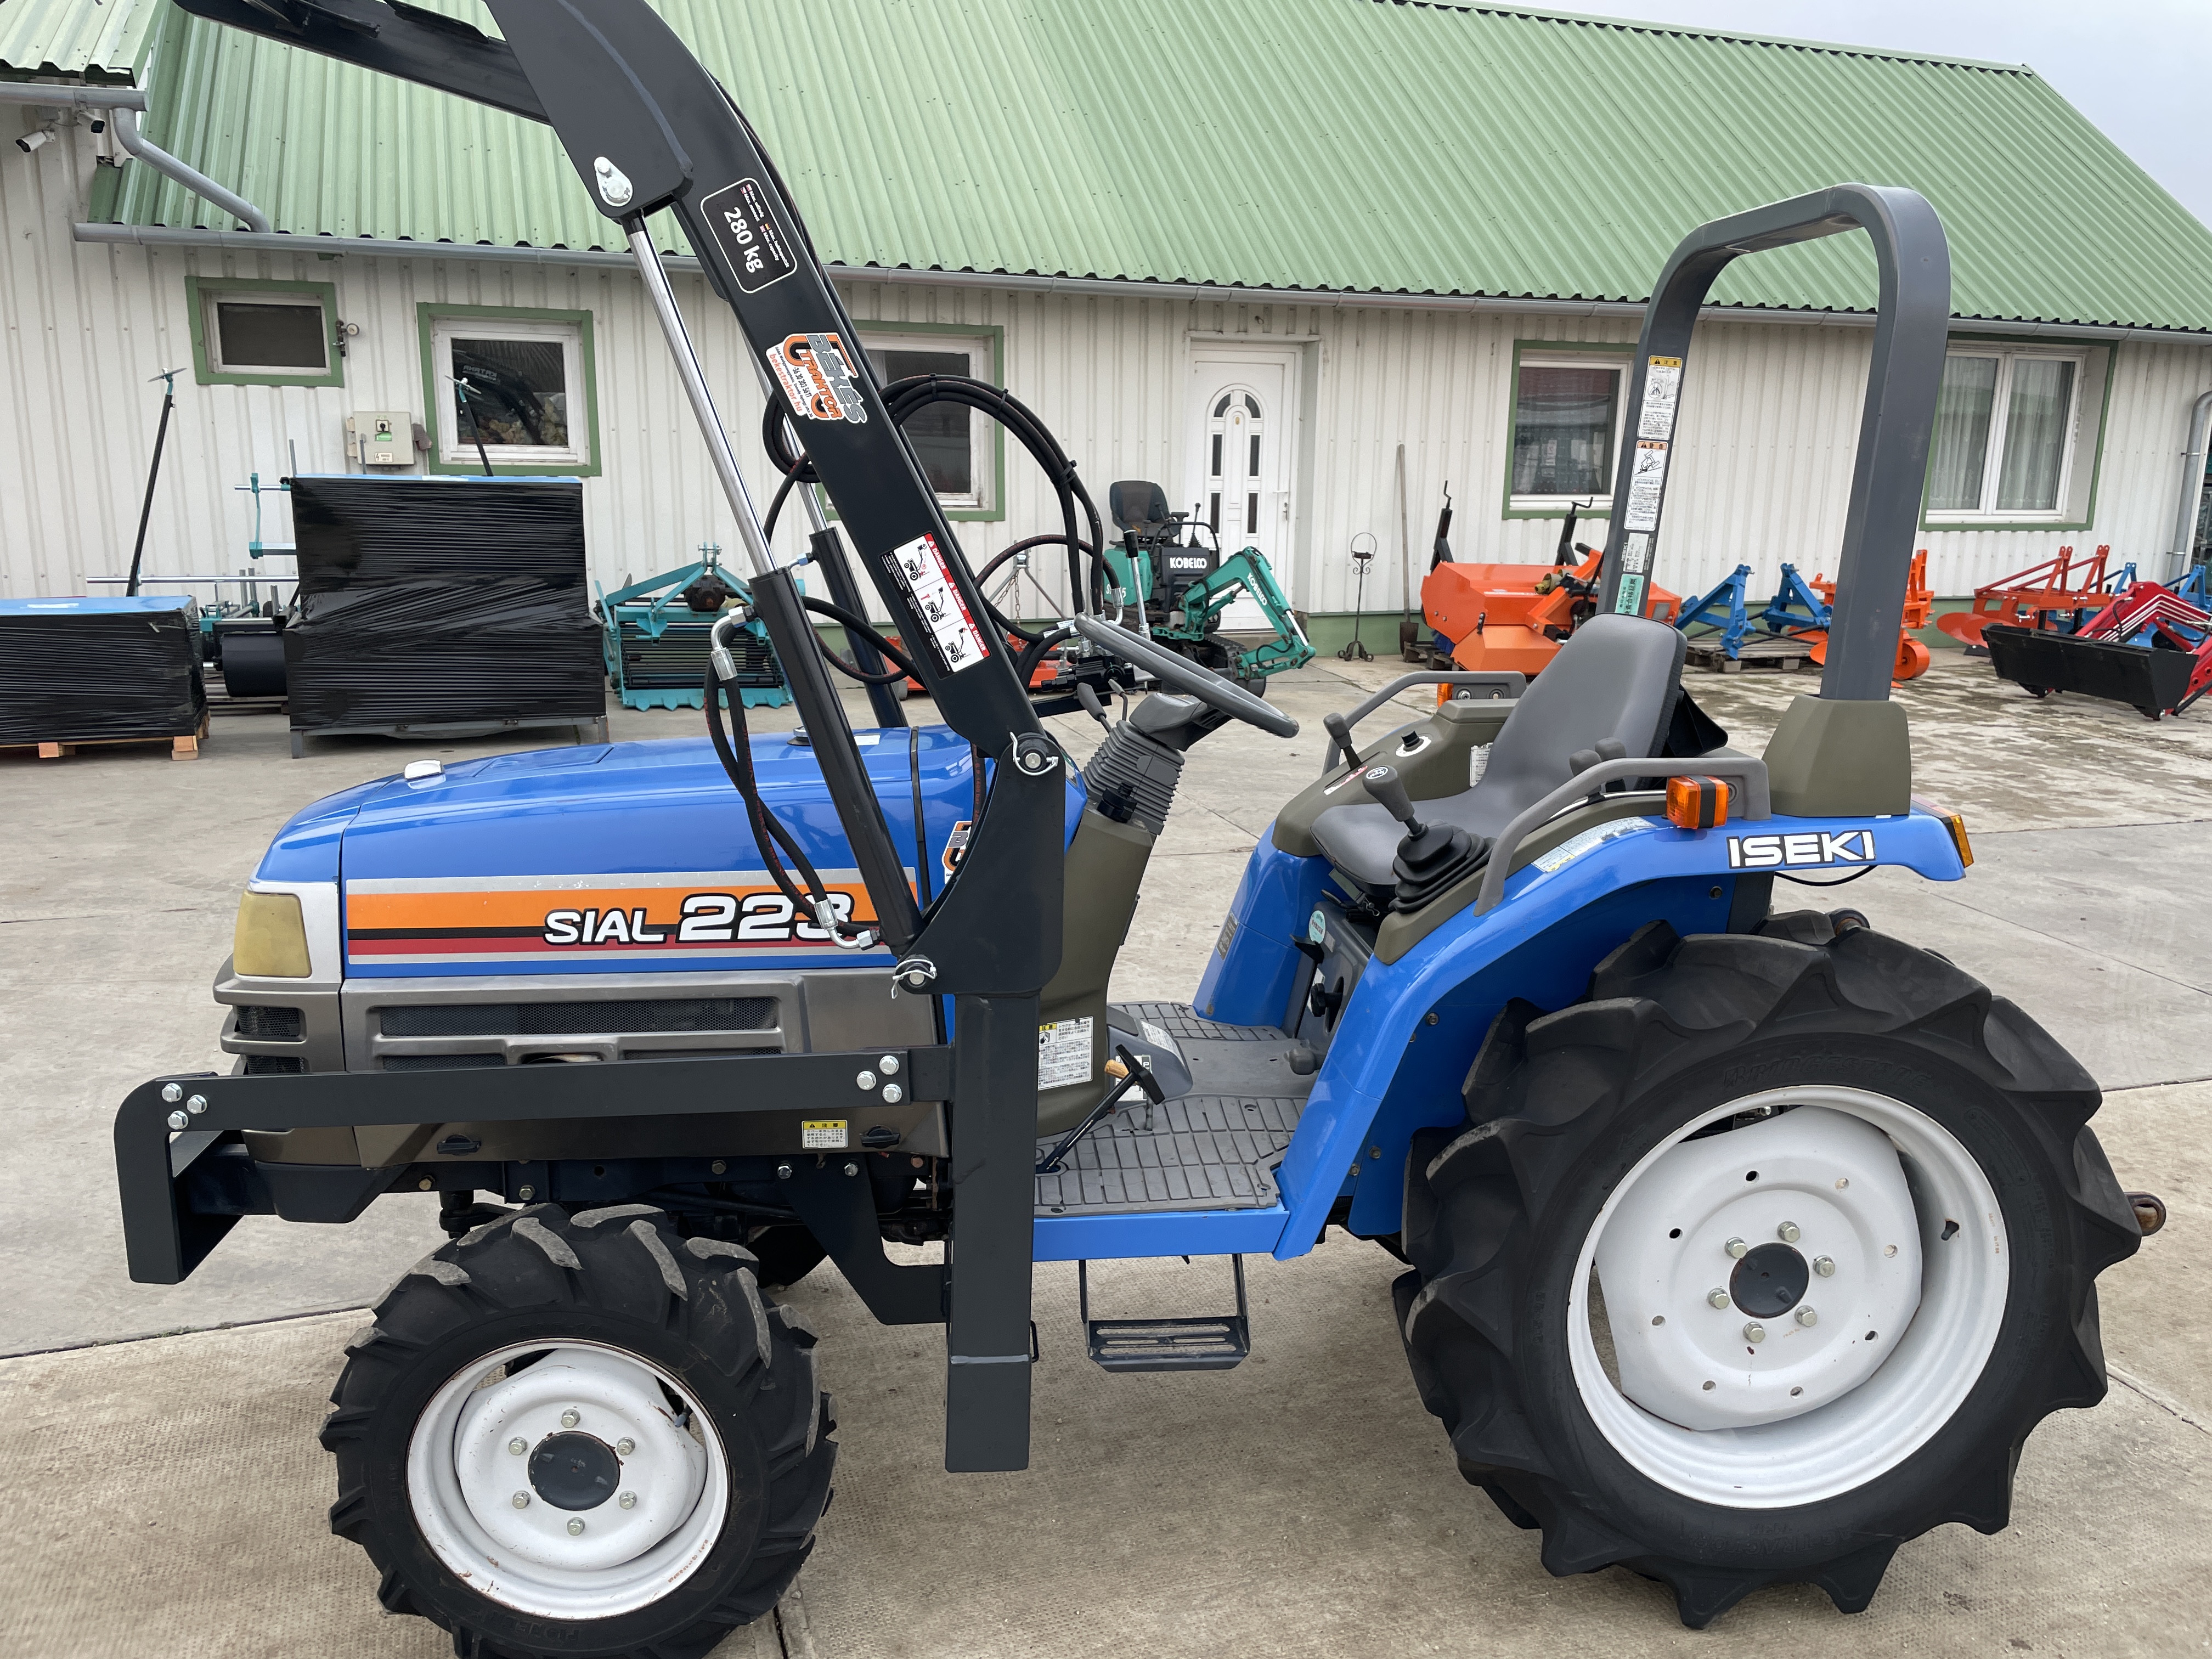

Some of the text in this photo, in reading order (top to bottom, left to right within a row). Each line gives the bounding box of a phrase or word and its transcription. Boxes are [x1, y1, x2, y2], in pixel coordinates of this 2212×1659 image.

[724, 207, 763, 273] 280 kg
[770, 354, 802, 411] bekestraktor.hu
[798, 349, 842, 419] TRAKTOR
[808, 335, 866, 422] BÉKÉS
[933, 548, 946, 571] DANGER
[1170, 557, 1207, 569] KOBELCO
[952, 589, 966, 612] DANGER
[1247, 572, 1267, 606] KOBELCO
[972, 629, 986, 652] DANGER
[1728, 830, 1876, 869] ISEKI
[545, 892, 855, 944] SIAL 223
